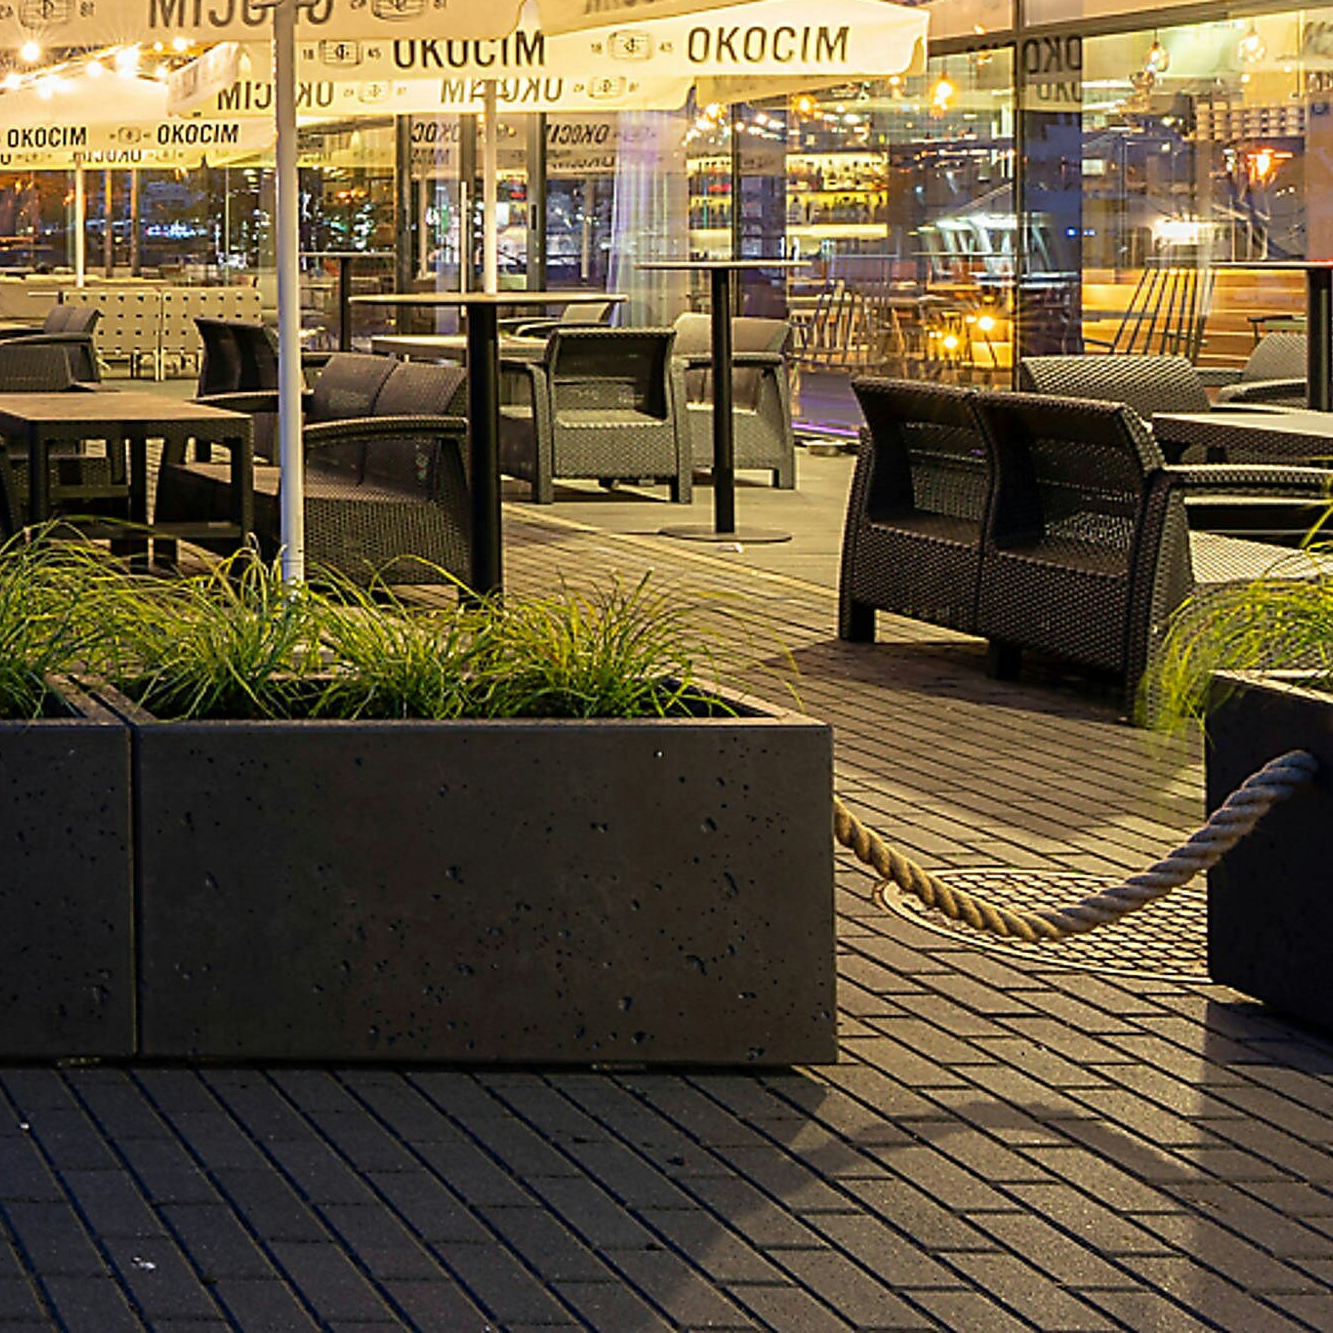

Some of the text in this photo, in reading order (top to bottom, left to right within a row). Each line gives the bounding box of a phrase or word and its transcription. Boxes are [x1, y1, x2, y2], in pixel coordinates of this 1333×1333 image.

[687, 26, 850, 64] OKOCIM
[7, 127, 87, 148] OKOCIM
[157, 124, 239, 145] OKOCIM
